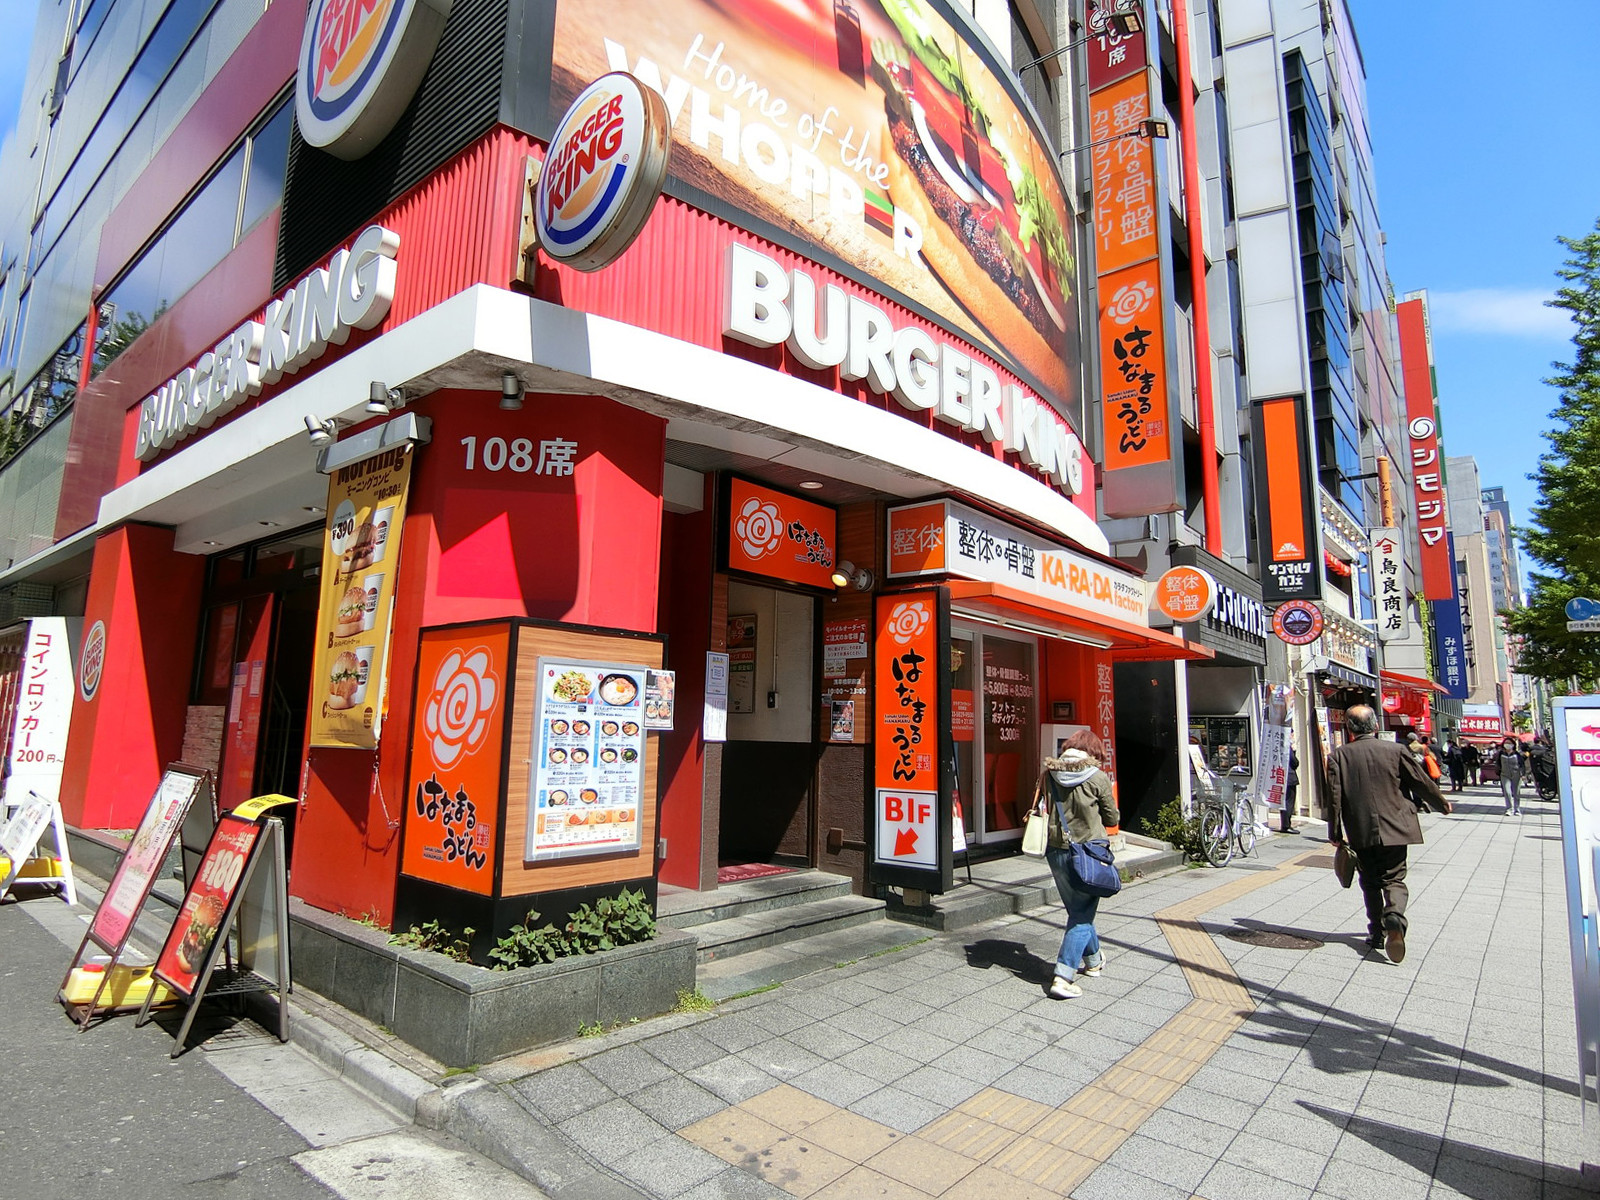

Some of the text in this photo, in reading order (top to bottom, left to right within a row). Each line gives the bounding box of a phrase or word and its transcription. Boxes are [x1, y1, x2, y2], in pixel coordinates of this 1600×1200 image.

[1108, 45, 1126, 67] 席
[683, 33, 891, 190] Home of the
[547, 94, 624, 192] BURGER
[548, 117, 624, 228] KING
[134, 225, 401, 462] BURGER KING
[724, 241, 1083, 495] BURGER KING
[461, 436, 578, 477] 108席
[1413, 448, 1444, 546] シモジマ
[893, 522, 943, 556] 整体
[1166, 574, 1200, 593] 整体
[1268, 562, 1311, 576] サンマルク
[1278, 575, 1303, 587] カフェ
[1114, 589, 1143, 616] factory
[1166, 594, 1199, 612] 骨盤
[1380, 557, 1402, 630] 鳥良商店
[86, 637, 103, 660] BURGER
[328, 632, 334, 649] B
[85, 651, 102, 676] KING
[1444, 636, 1460, 686] みずほ銀行
[21, 633, 52, 747] コインロッカー
[1265, 764, 1285, 804] 増量
[207, 849, 243, 893] 180
